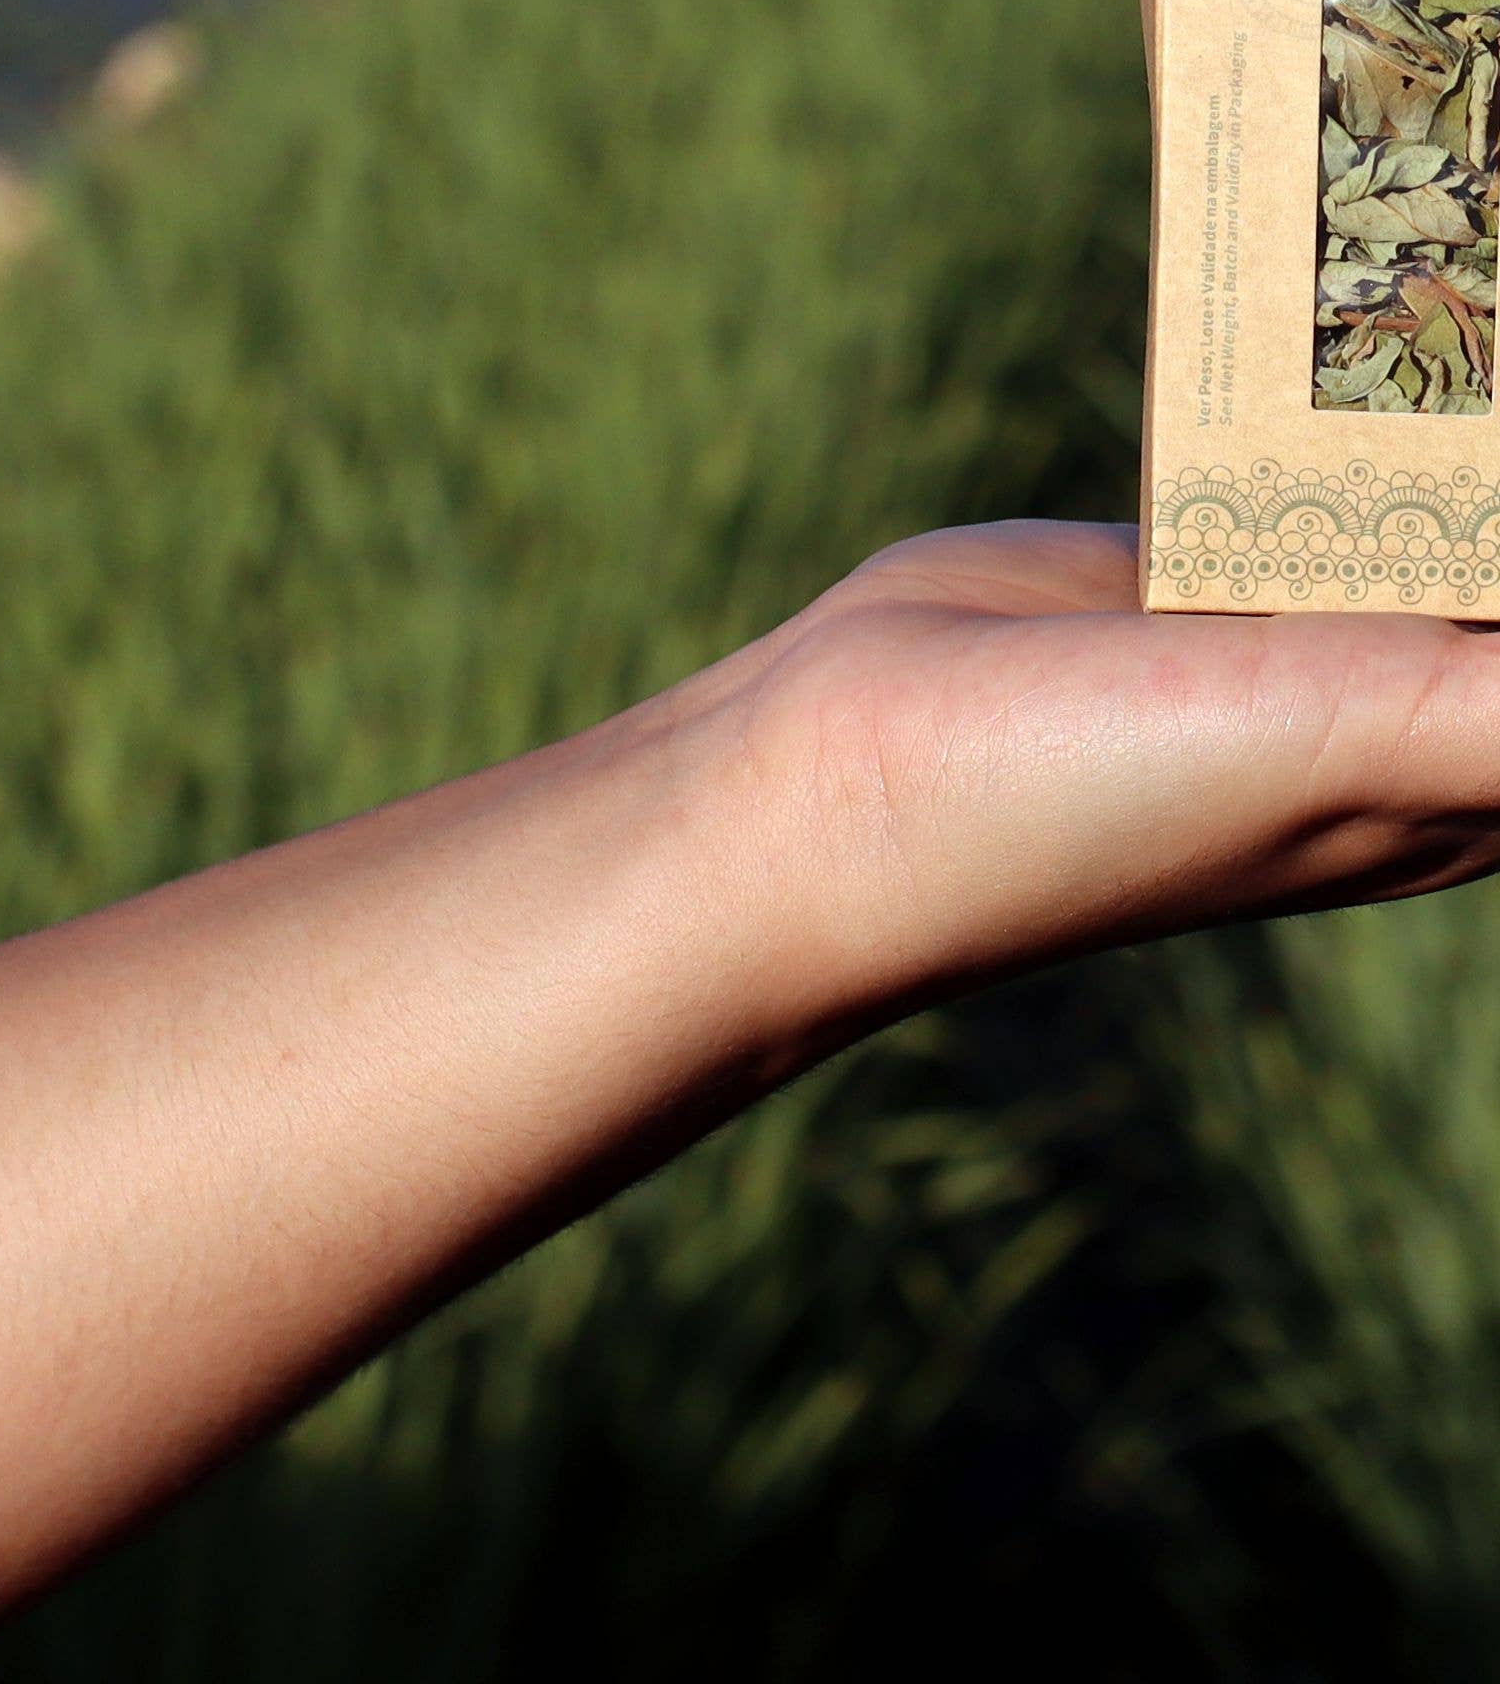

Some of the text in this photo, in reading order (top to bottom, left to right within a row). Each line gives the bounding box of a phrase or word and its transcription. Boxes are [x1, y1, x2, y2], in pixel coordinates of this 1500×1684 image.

[1197, 95, 1223, 427] Ver Peso, Lote e Validade na embalagem
[1219, 32, 1247, 427] See Net Weight, Batch and Validity in Packaging
